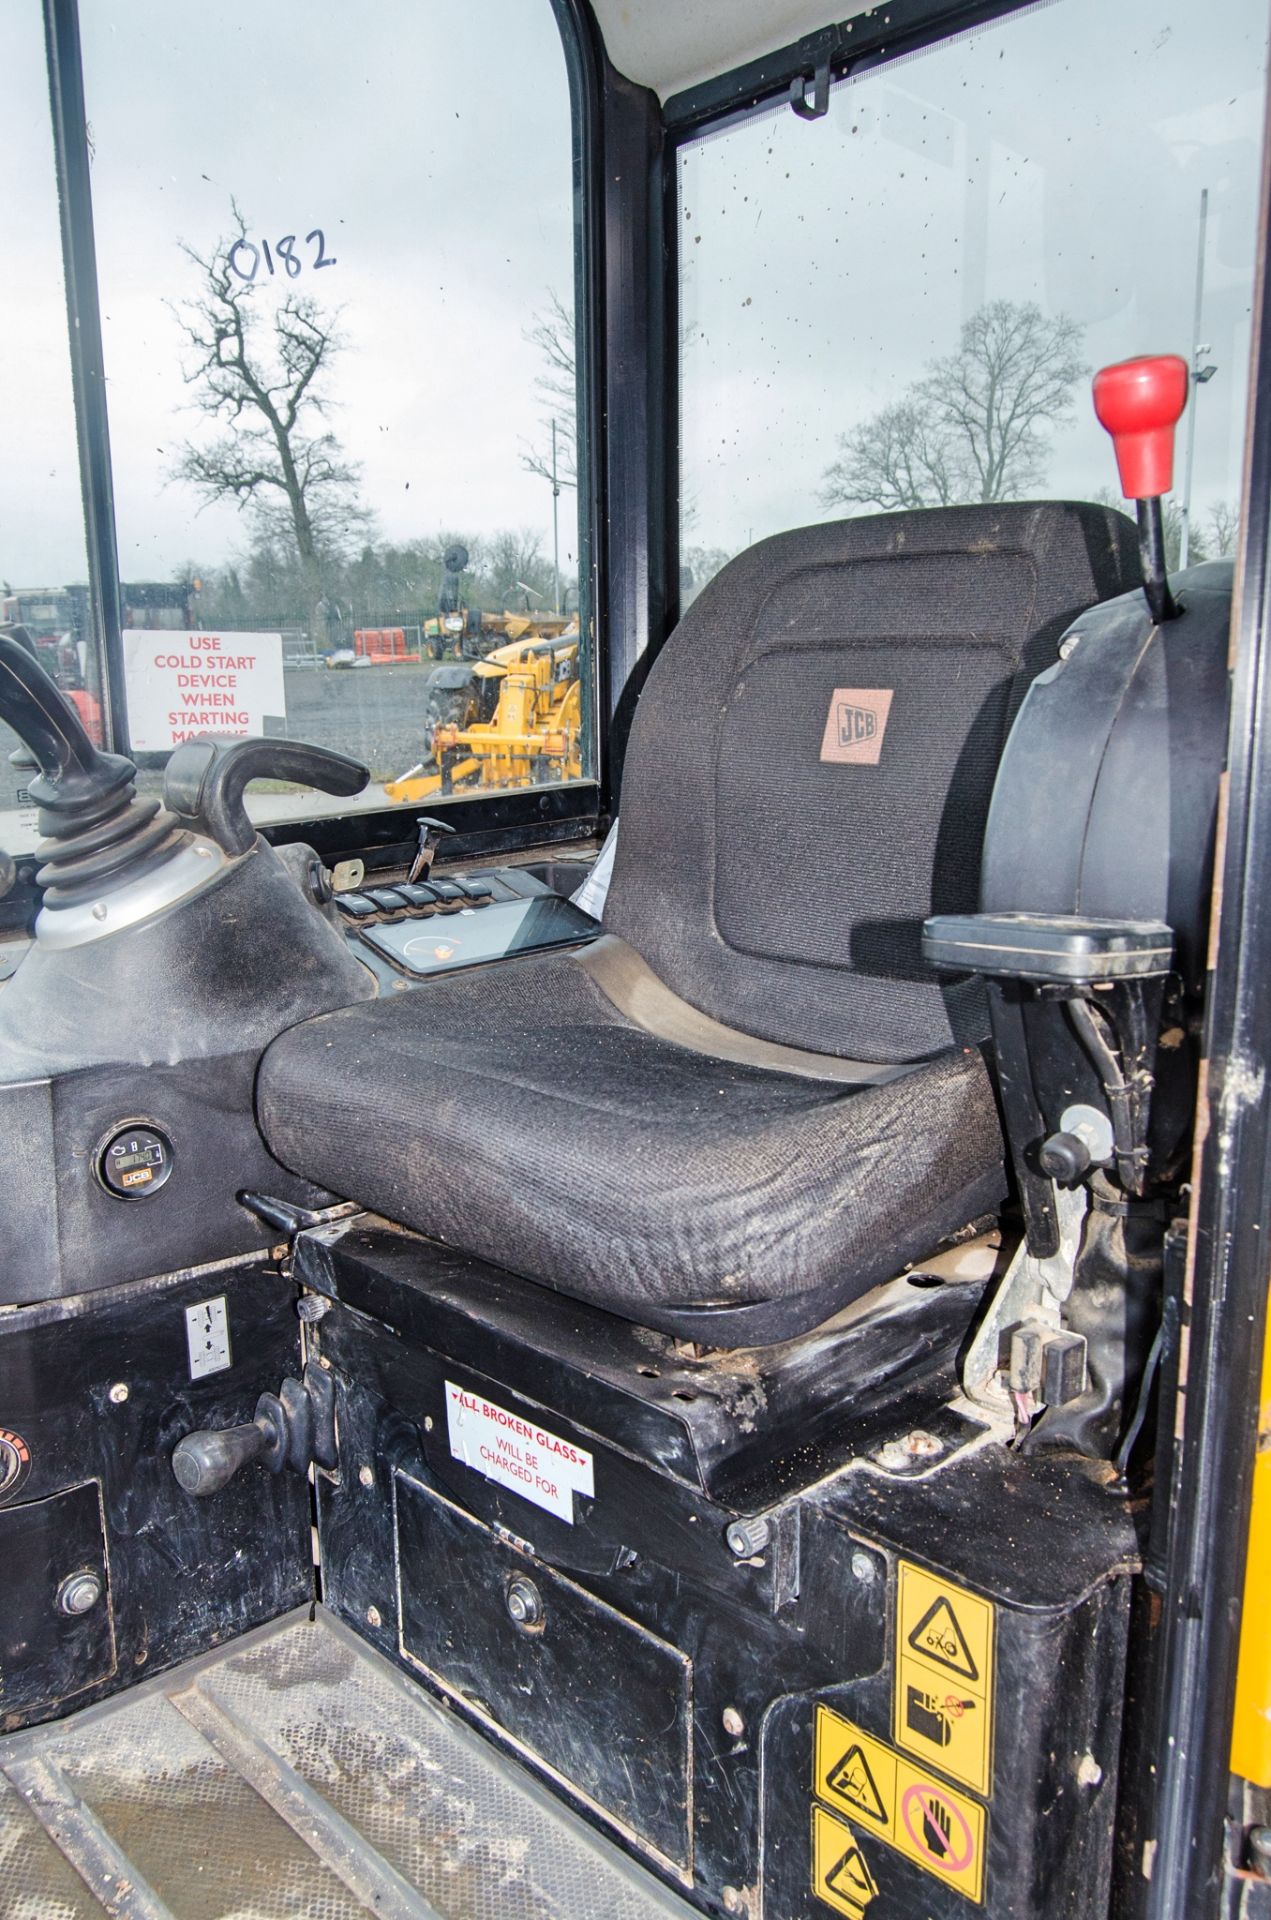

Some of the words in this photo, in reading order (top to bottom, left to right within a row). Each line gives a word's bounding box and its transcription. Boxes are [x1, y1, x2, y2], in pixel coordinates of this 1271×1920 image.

[228, 229, 337, 281] 0182
[189, 637, 221, 650] USE
[154, 655, 202, 668] COLD
[206, 656, 256, 670] START
[177, 674, 237, 688] DEVICE
[181, 693, 235, 706] WHEN
[168, 712, 249, 725] STARTING
[841, 708, 875, 742] JCB
[127, 1171, 149, 1183] JCB
[482, 1403, 533, 1440] BROKEN
[536, 1432, 578, 1464] GLASS
[496, 1436, 523, 1462] WILL
[525, 1452, 539, 1471] BE
[479, 1445, 533, 1484] CHARGED
[535, 1476, 558, 1499] FOR
